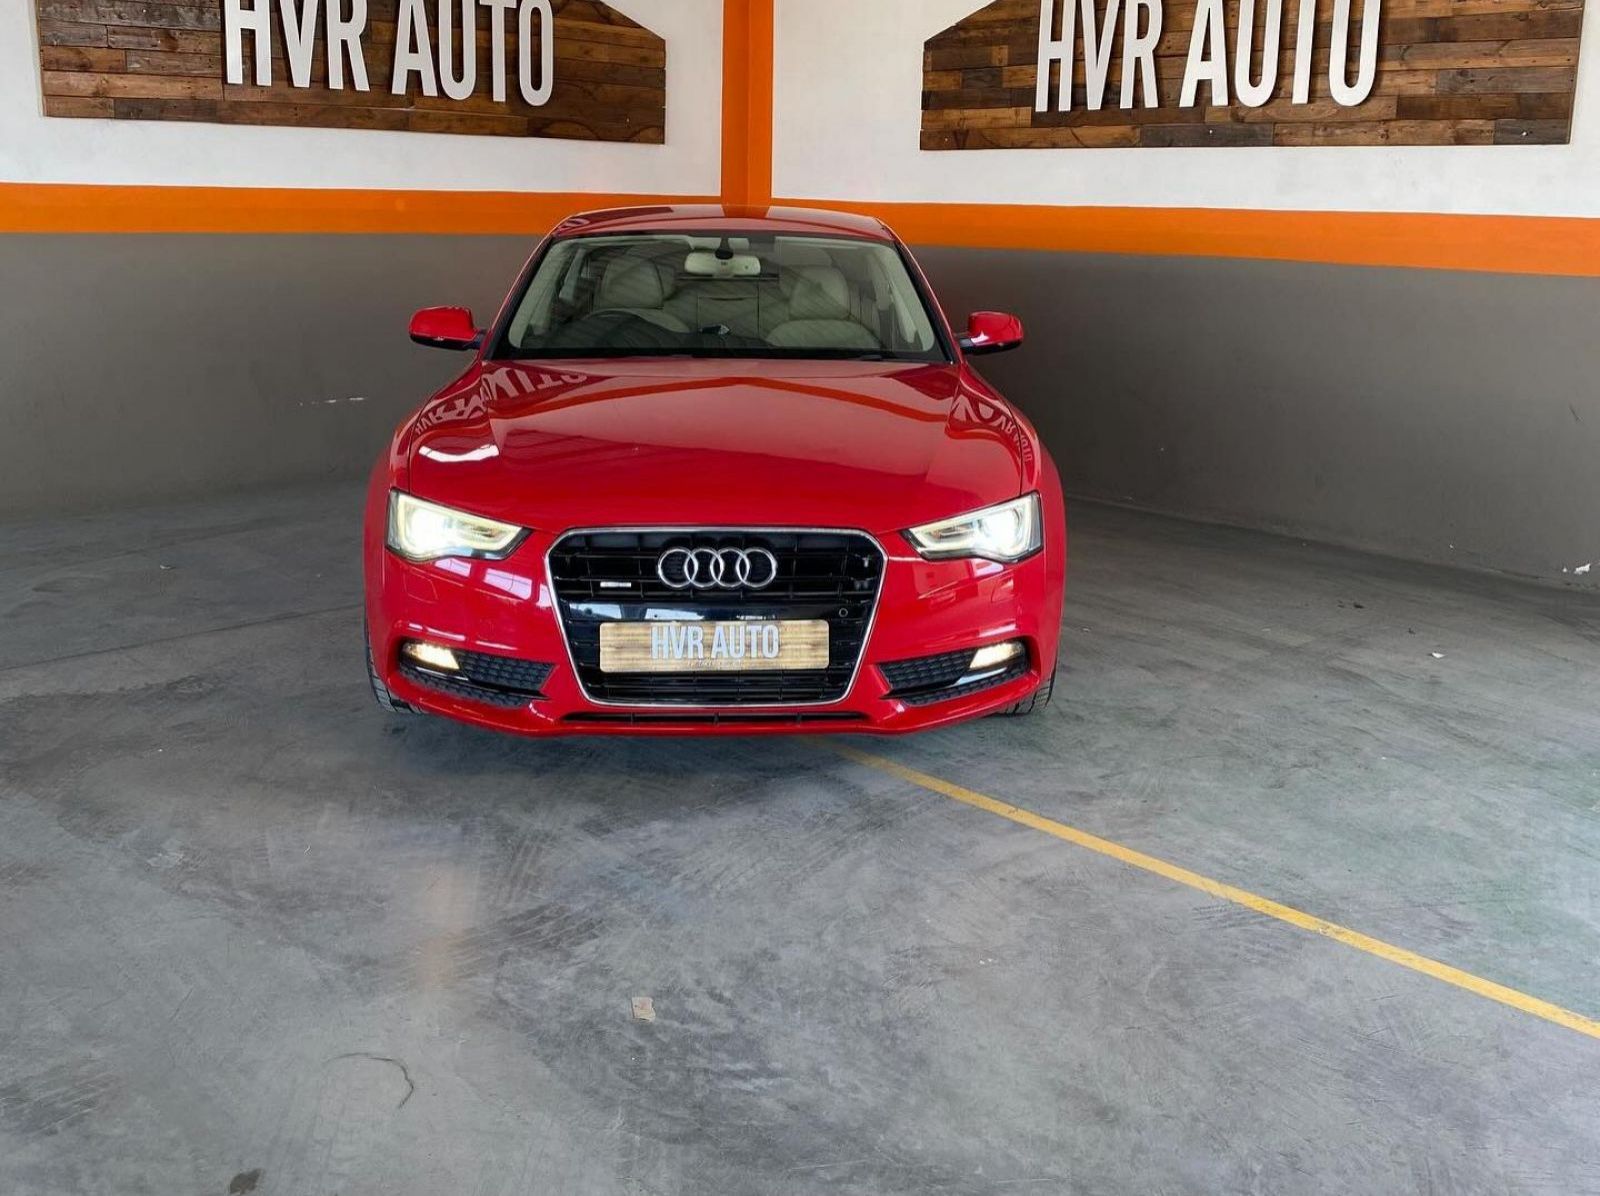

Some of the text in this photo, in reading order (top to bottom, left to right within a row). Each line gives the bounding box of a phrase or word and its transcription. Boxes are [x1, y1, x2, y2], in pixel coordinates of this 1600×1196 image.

[225, 0, 554, 106] HVR AUTO
[1035, 0, 1163, 112] HVR
[652, 625, 780, 659] HVR AUTO
